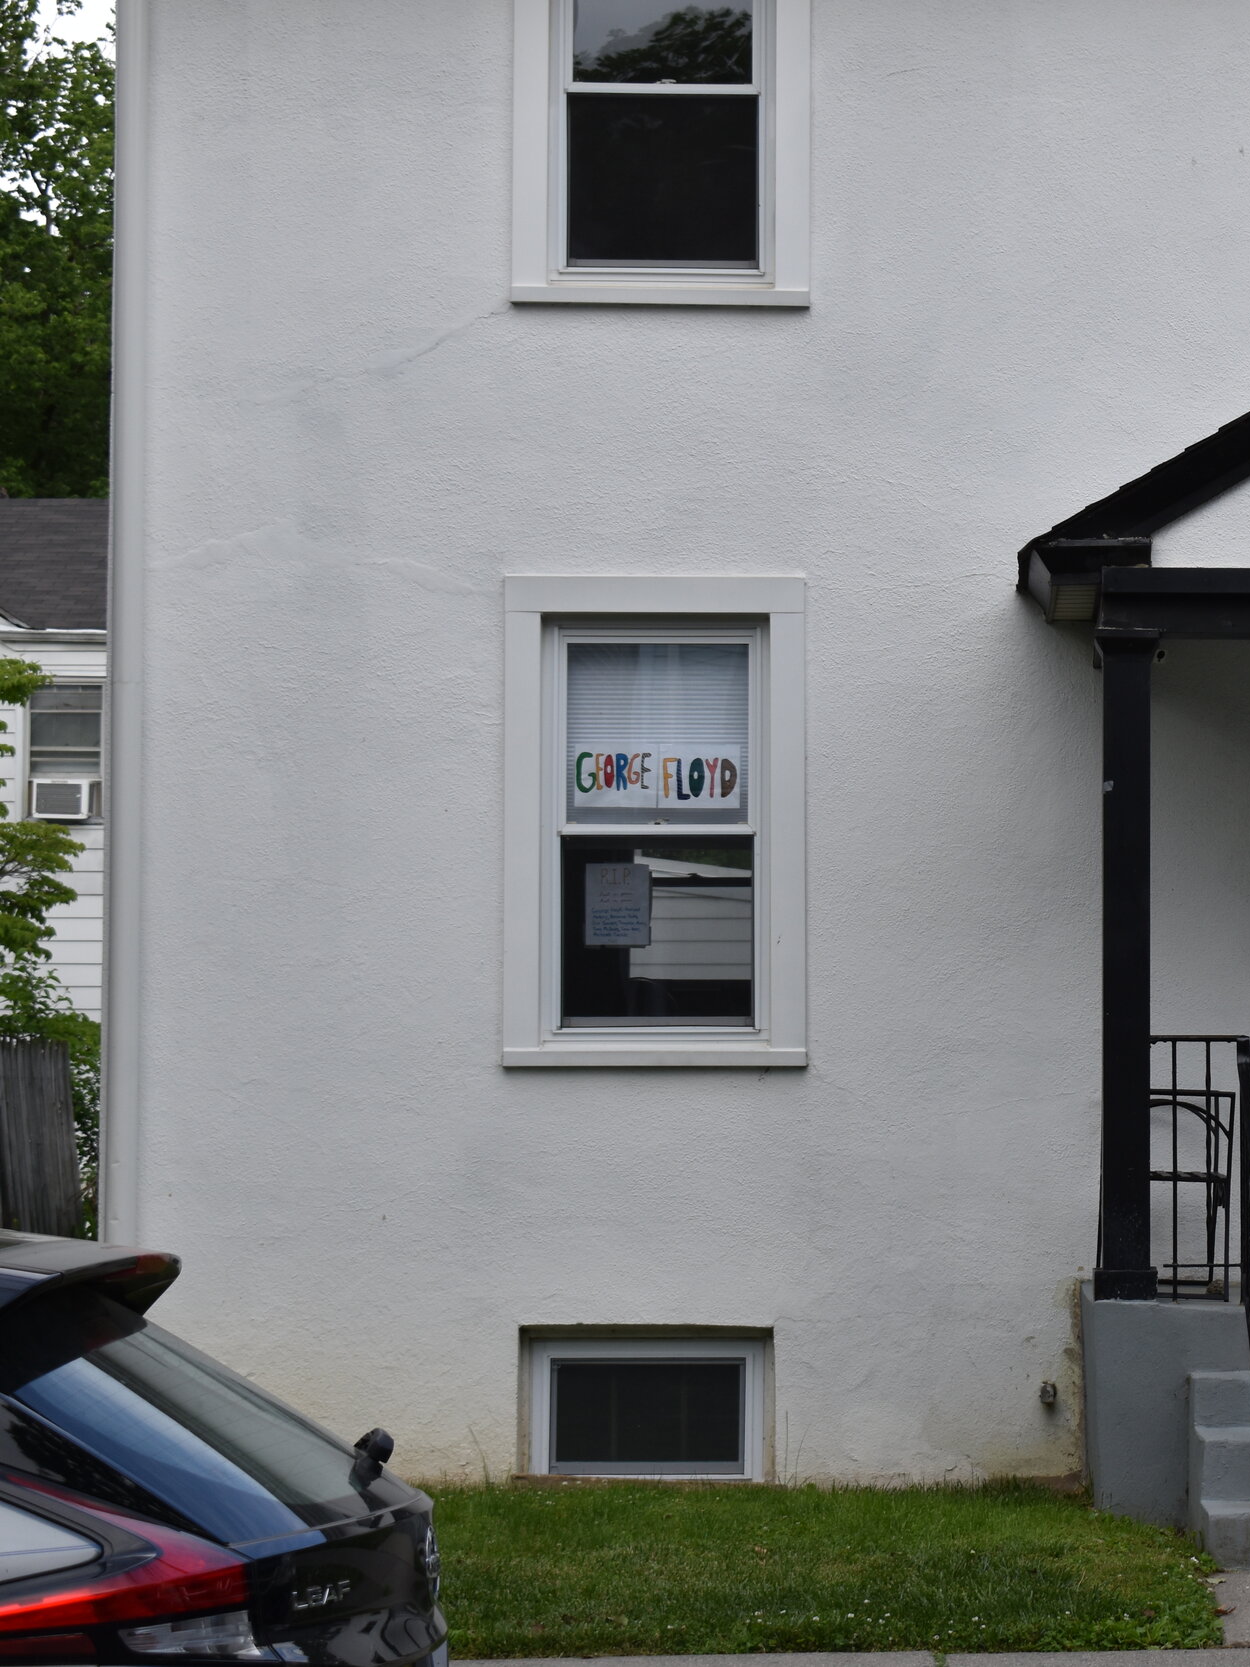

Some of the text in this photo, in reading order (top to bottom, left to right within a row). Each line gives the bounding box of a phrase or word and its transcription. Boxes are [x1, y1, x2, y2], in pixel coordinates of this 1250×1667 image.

[576, 752, 738, 800] GEORGE FLOYD
[292, 1579, 351, 1609] LEAF
